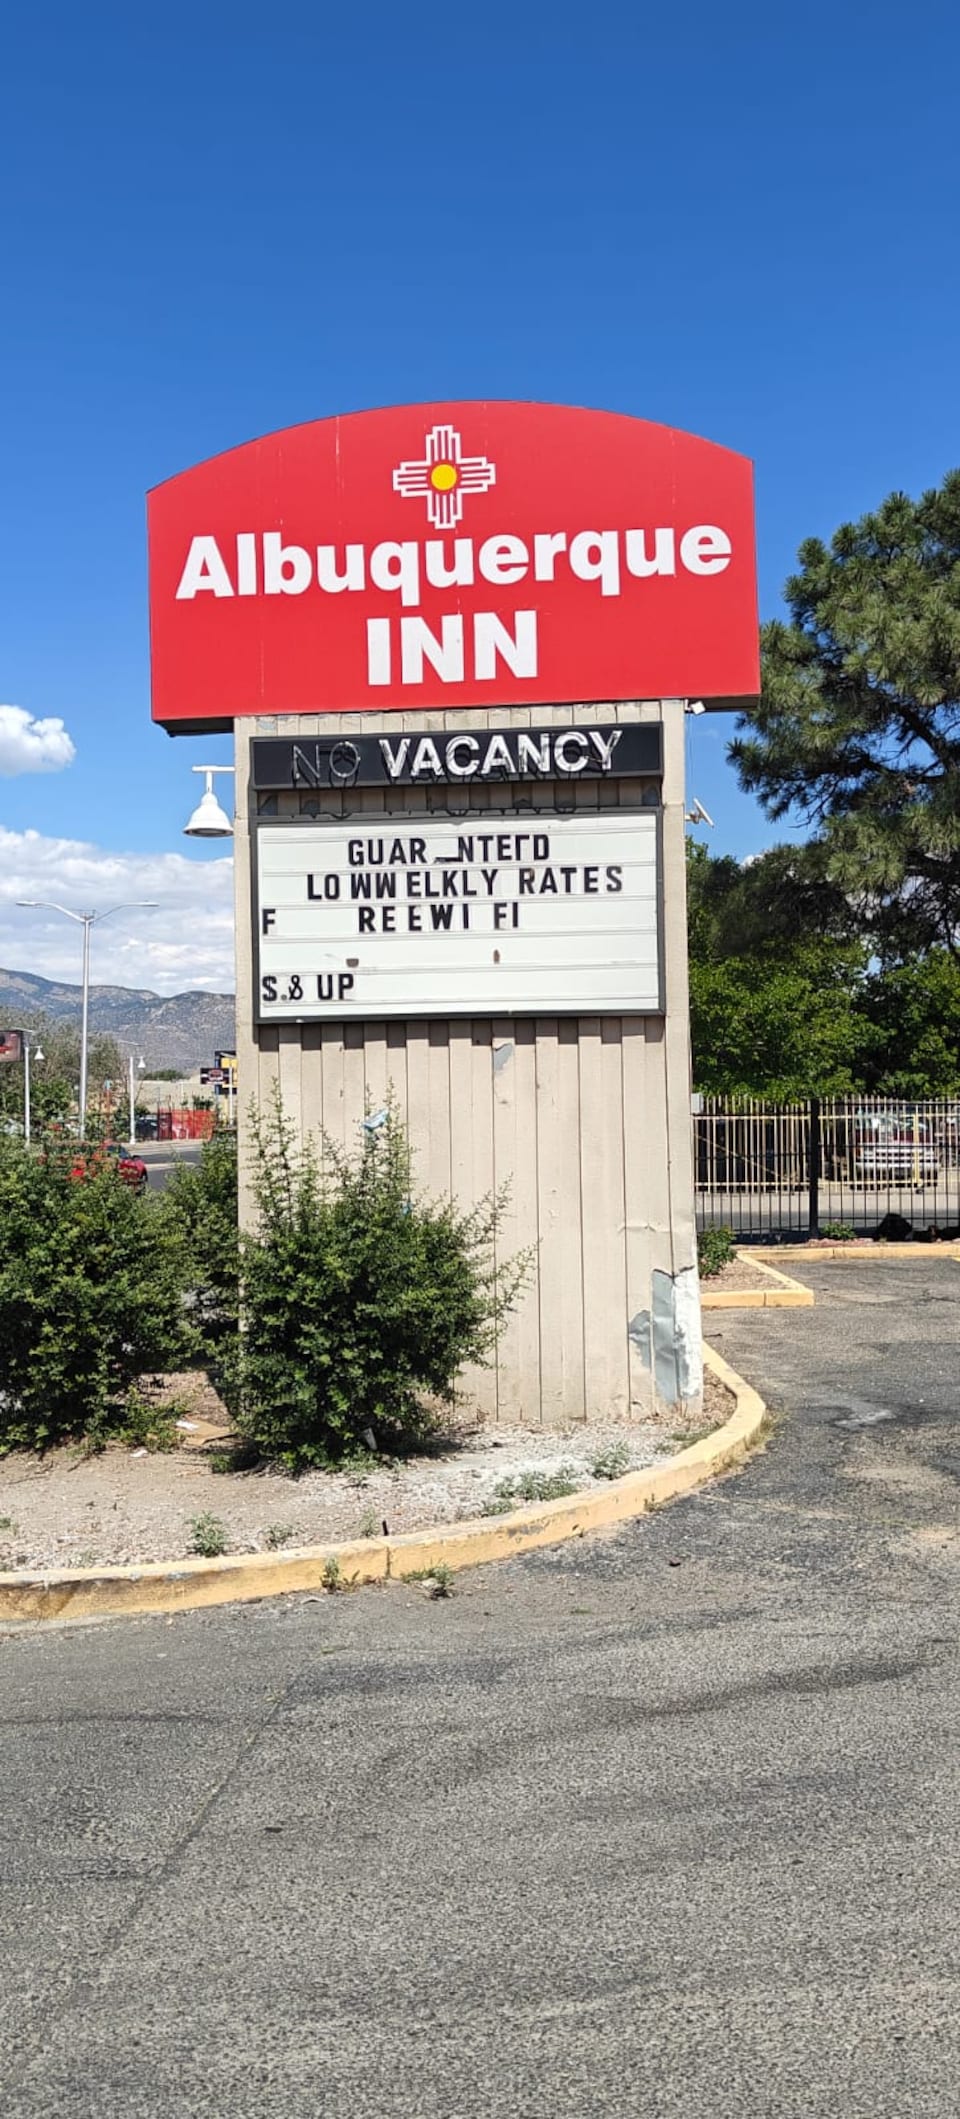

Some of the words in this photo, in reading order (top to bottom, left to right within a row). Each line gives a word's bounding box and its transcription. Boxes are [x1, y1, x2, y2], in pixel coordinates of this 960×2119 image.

[176, 523, 732, 606] Albuquerque
[367, 610, 538, 685] INN
[292, 741, 361, 779] NO
[379, 730, 623, 778] VACANCY
[519, 866, 622, 895] RATES
[317, 973, 354, 1000] UP
